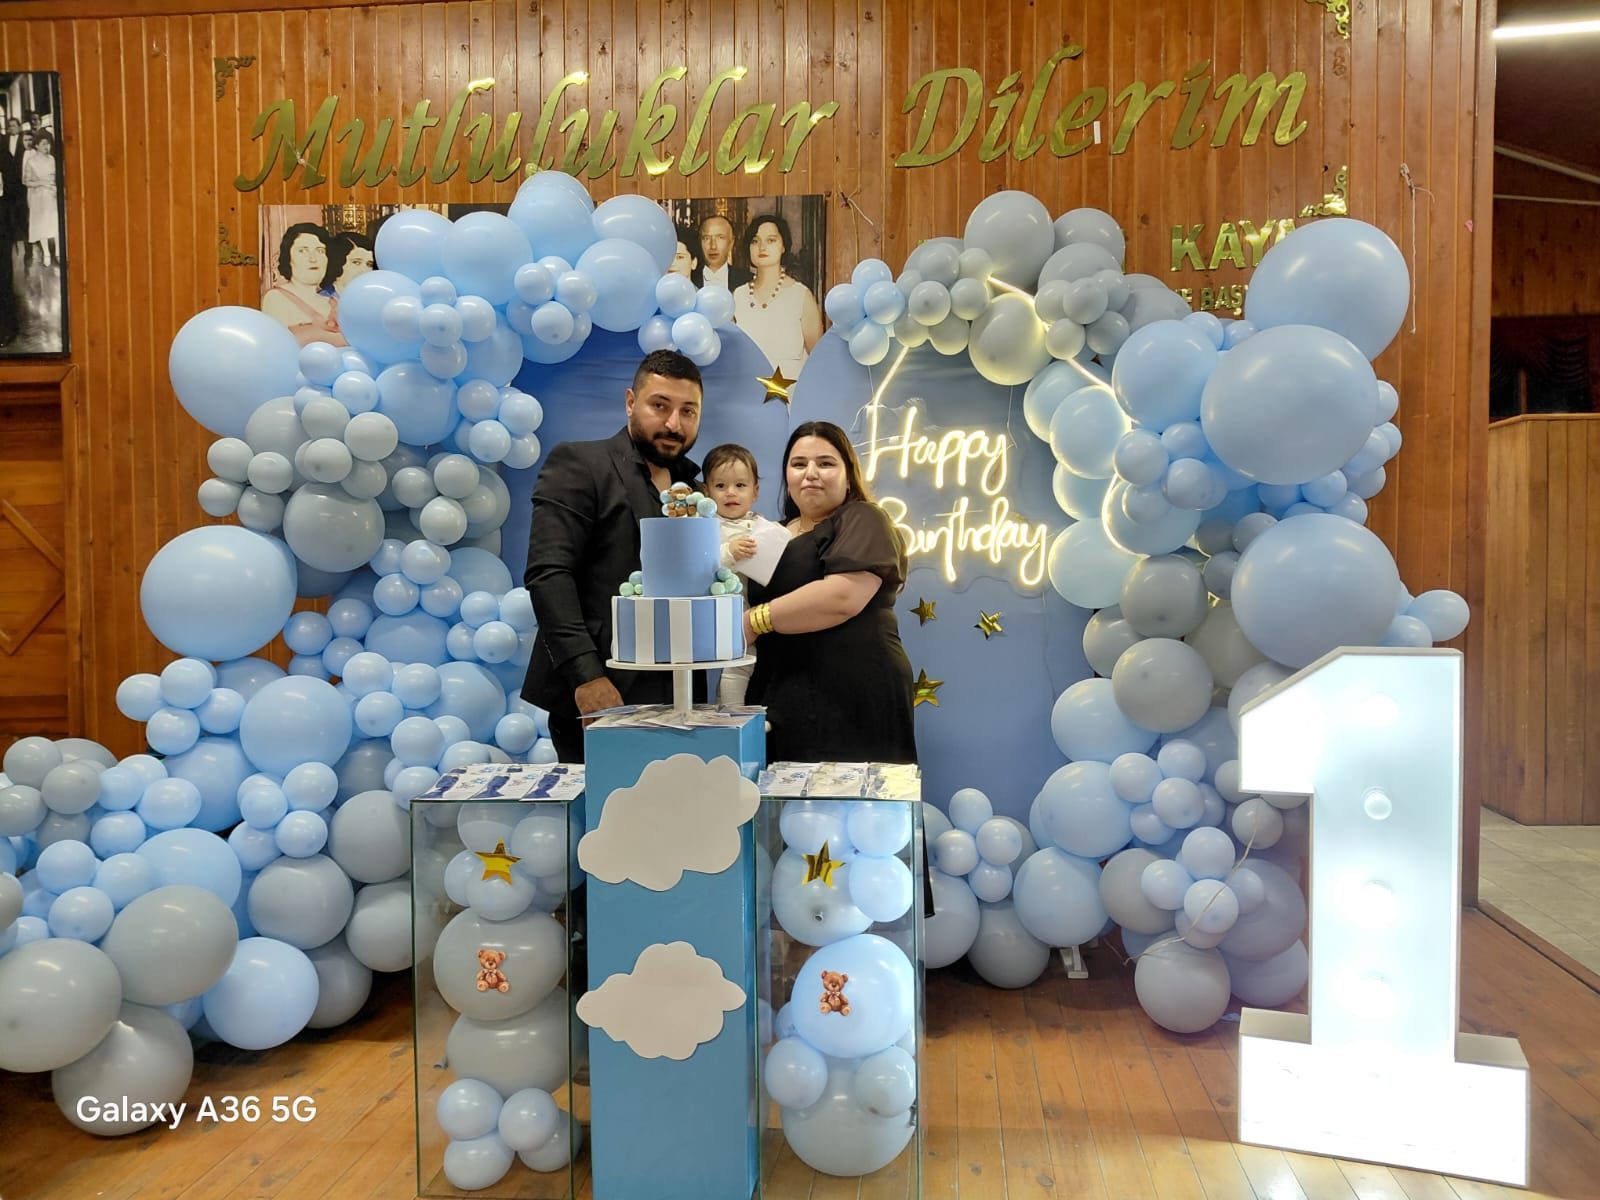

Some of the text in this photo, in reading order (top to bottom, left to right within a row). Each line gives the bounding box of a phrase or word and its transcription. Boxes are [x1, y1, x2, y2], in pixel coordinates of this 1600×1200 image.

[234, 44, 1308, 191] Mutluluklar Dilerim
[1200, 284, 1248, 316] BAŞ
[863, 406, 1008, 496] Happy
[878, 496, 1048, 586] Birthday
[1238, 646, 1530, 1187] 1
